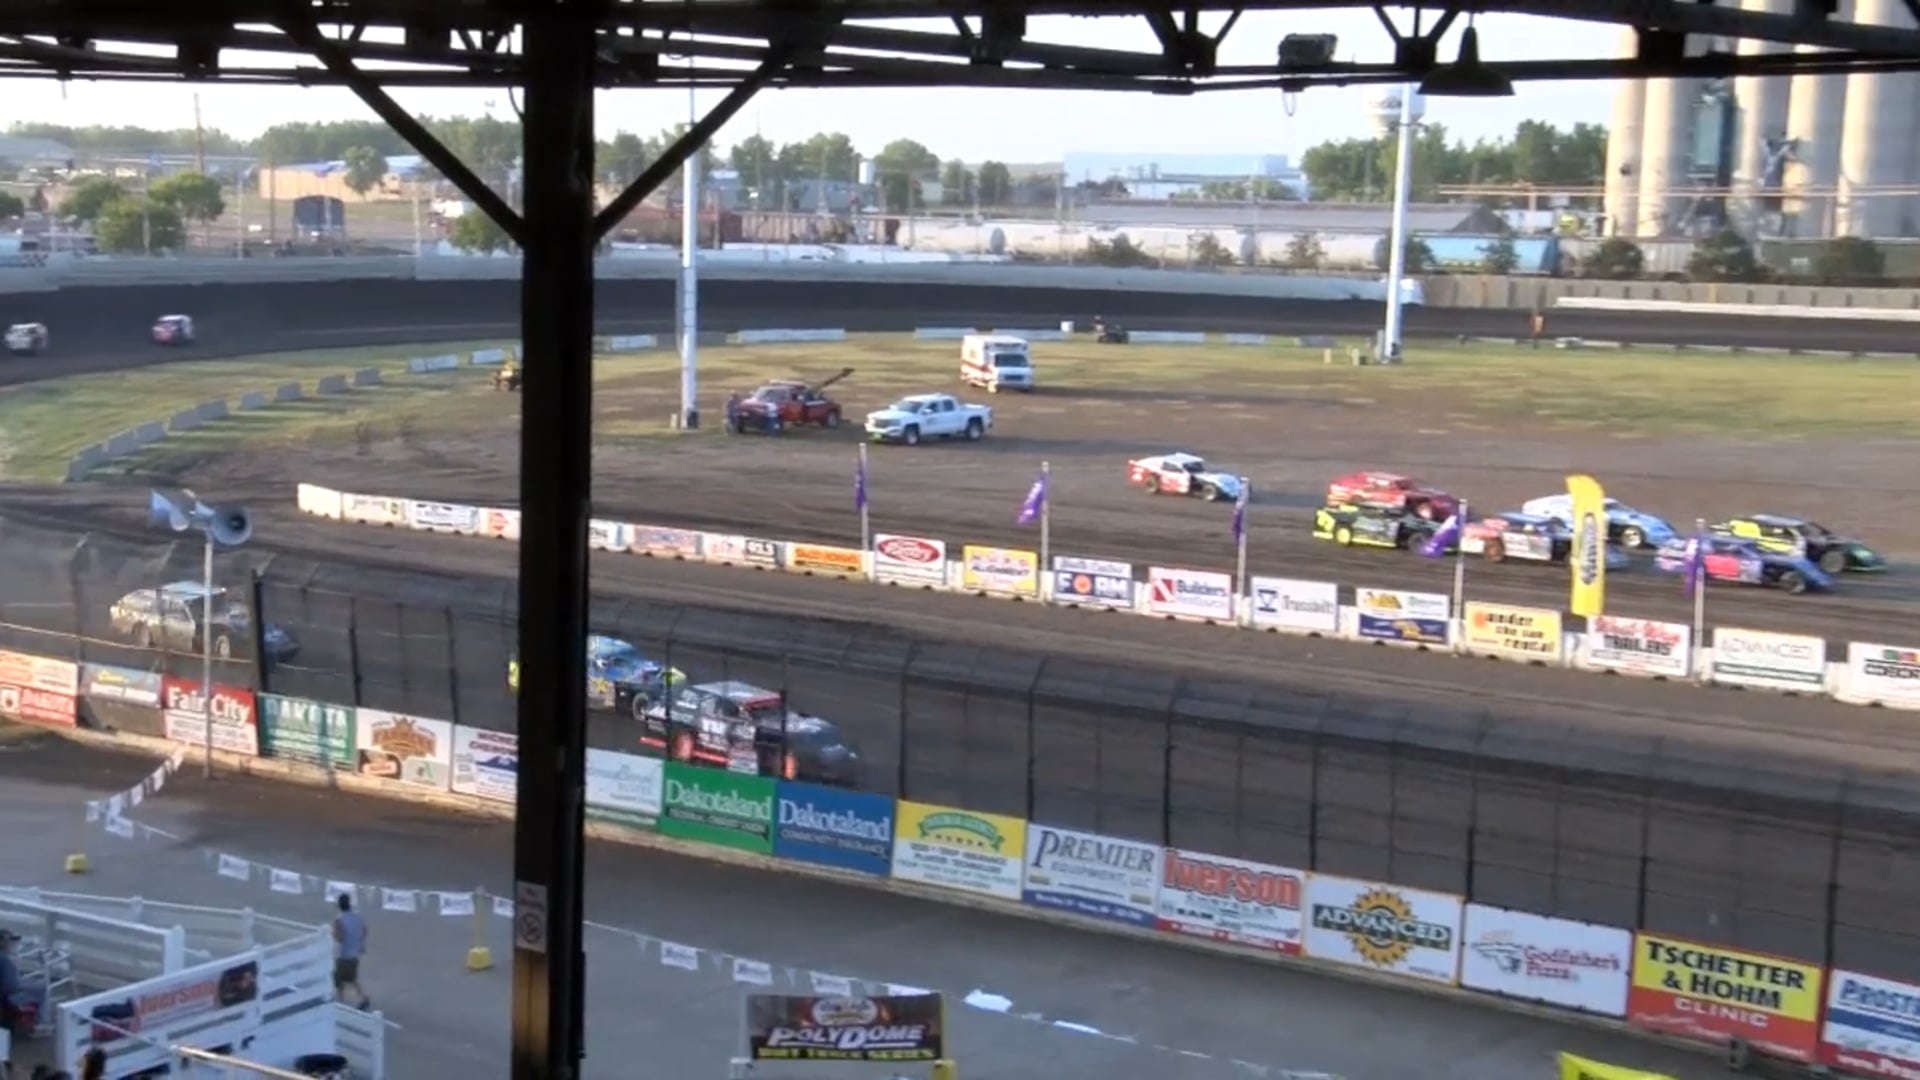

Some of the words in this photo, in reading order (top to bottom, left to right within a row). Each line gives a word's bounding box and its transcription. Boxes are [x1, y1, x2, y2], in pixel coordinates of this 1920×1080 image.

[167, 686, 206, 713] Fair
[210, 692, 251, 727] City
[665, 779, 772, 821] Dakotaland
[778, 797, 891, 842] Dakotaland
[1029, 829, 1155, 873] PREMIER
[1162, 848, 1301, 911] Iverson
[1317, 906, 1450, 942] ADVANCED
[1524, 945, 1620, 970] Godfather's
[1646, 939, 1806, 990] TSCHETTER
[1662, 970, 1682, 991] &
[1690, 972, 1783, 1010] HOHM
[1674, 996, 1769, 1028] CLINIC
